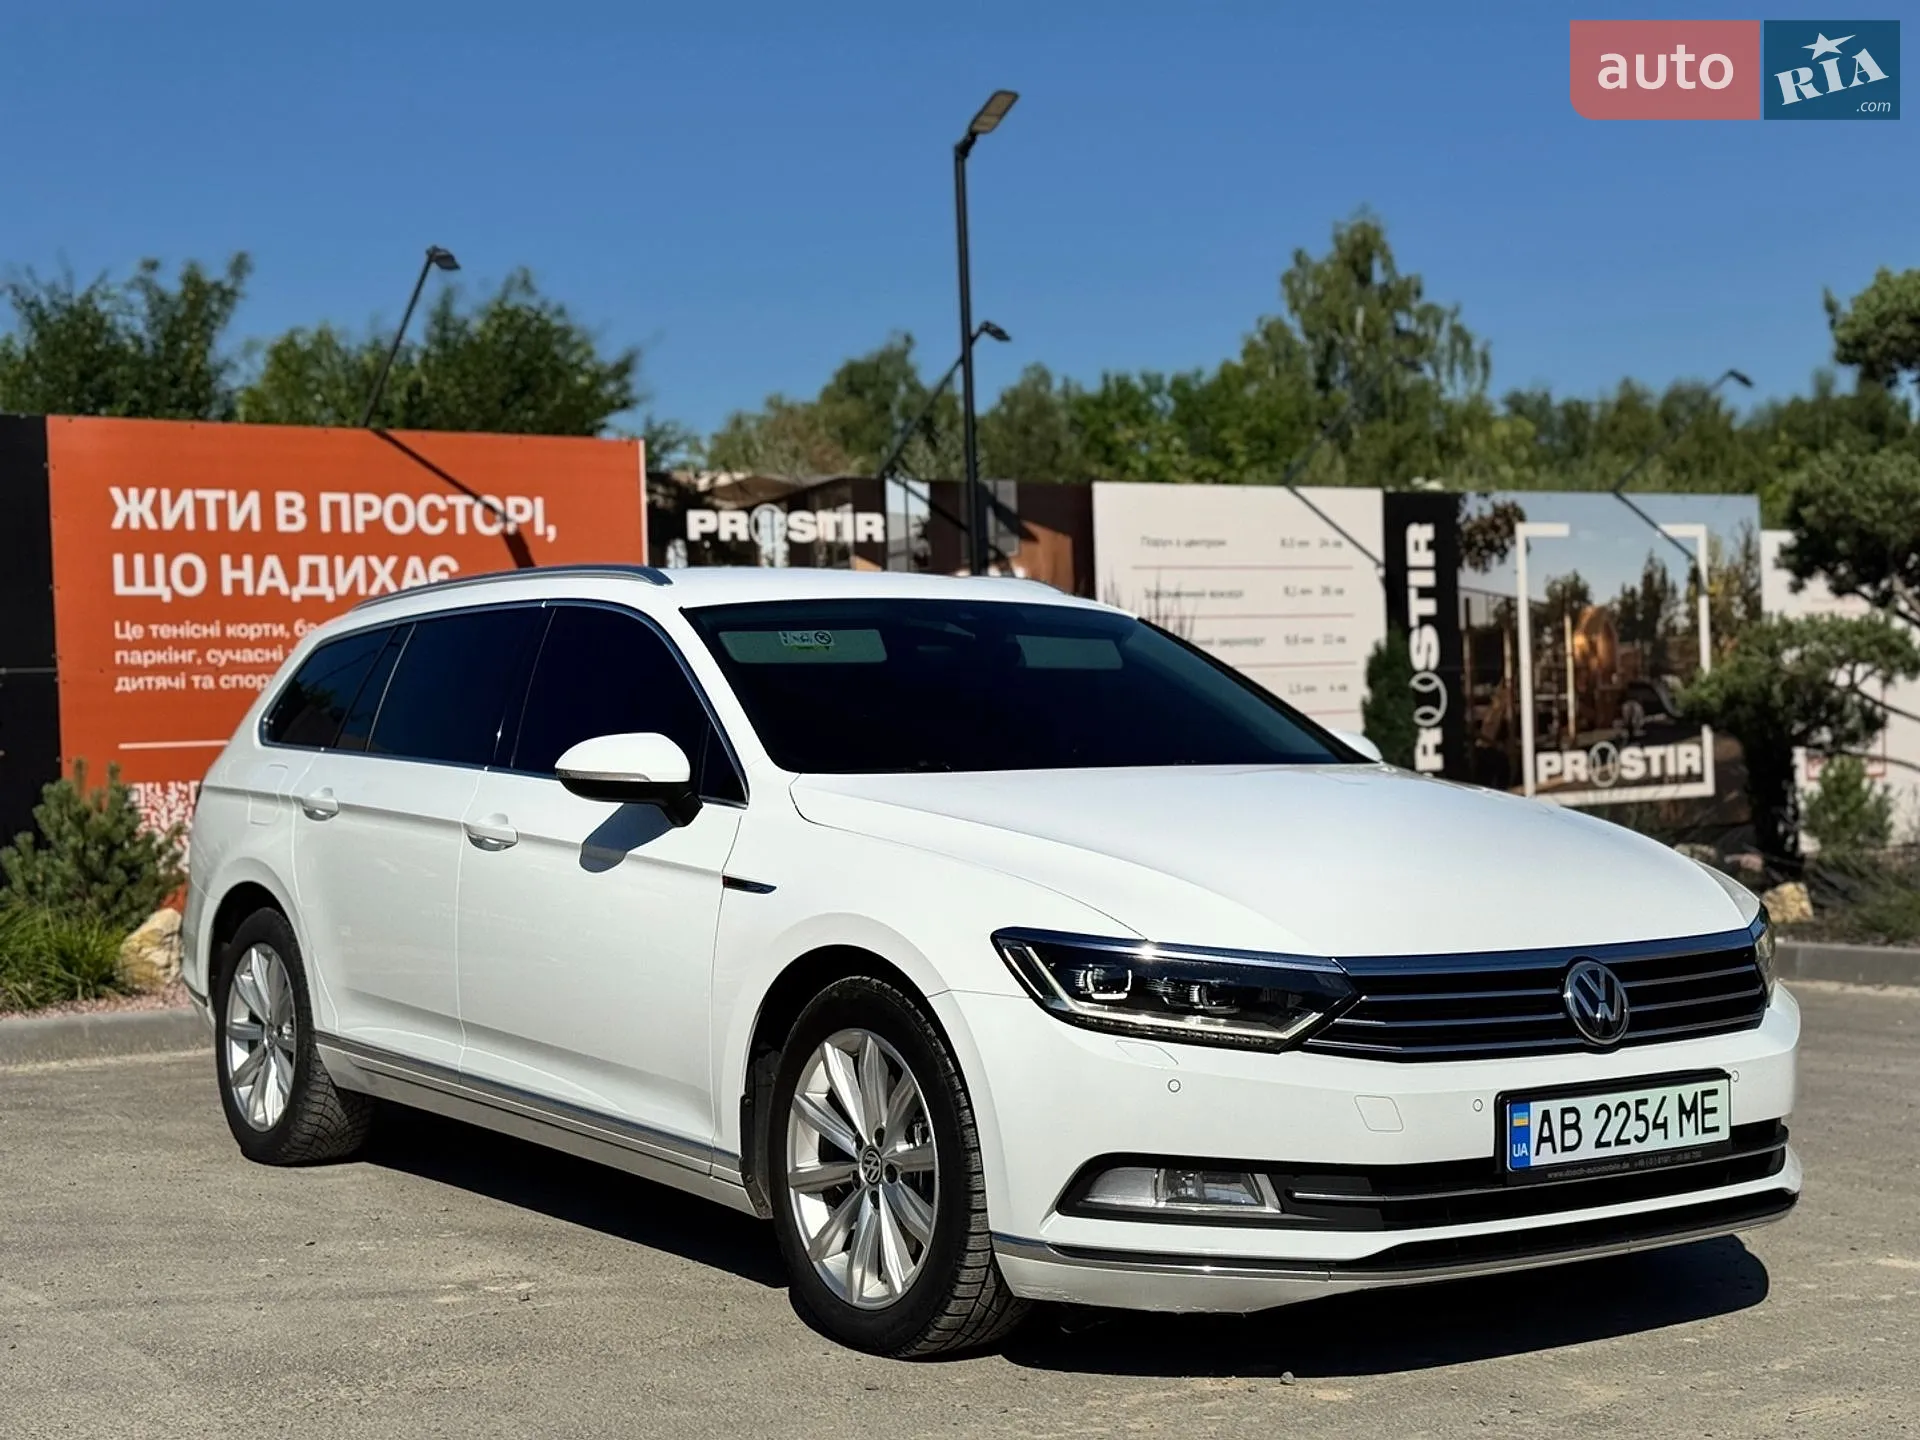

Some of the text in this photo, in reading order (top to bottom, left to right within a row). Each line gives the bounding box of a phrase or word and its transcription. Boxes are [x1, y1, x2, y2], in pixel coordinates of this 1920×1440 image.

[109, 486, 557, 543] ЖИТИ В ПРОСТОРІ,
[686, 503, 885, 544] PROSTIR
[113, 552, 460, 603] ЩО НАДИХАЄ
[115, 620, 144, 641] Це
[150, 620, 220, 640] тенісні
[226, 622, 291, 641] корти,
[115, 645, 283, 667] паркінг, сучасні
[115, 672, 186, 693] дитячі
[191, 674, 215, 690] та
[1536, 740, 1701, 787] PROSTIR
[1535, 1088, 1720, 1156] AB 2254 ME
[1513, 1143, 1528, 1157] UA
